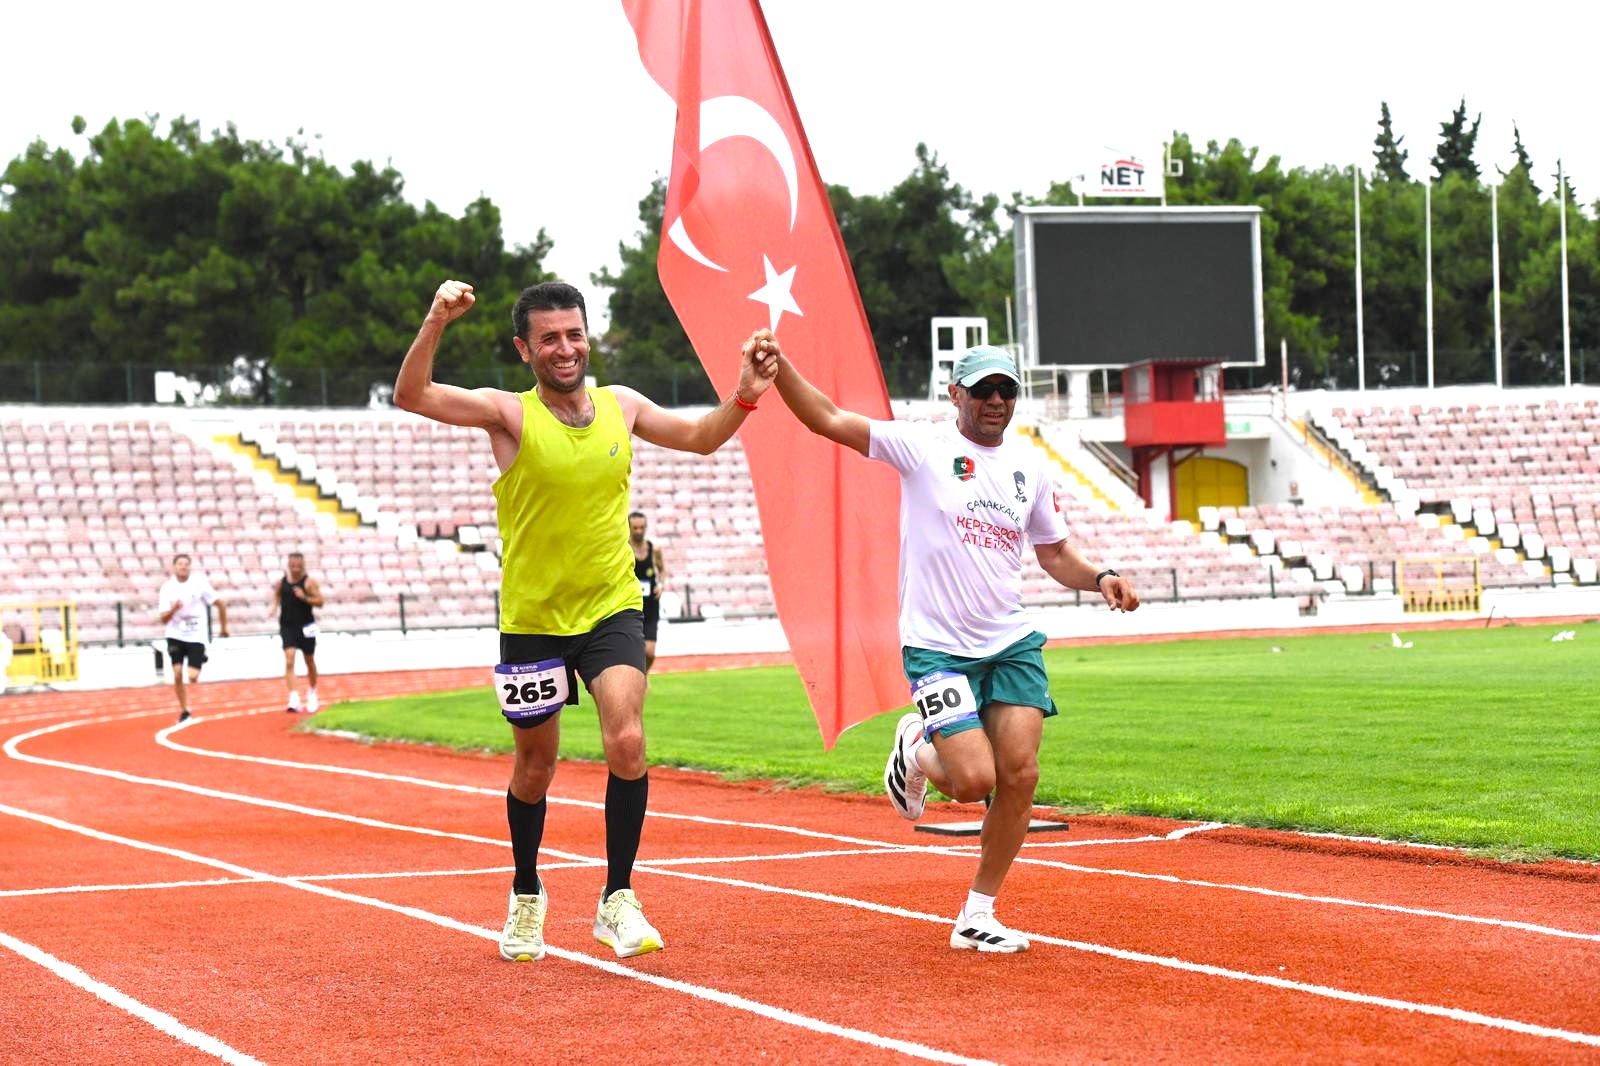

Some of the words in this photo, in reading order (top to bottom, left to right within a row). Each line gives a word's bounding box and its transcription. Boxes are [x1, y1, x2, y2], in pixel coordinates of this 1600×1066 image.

[1101, 167, 1145, 185] NET
[966, 500, 1021, 525] ÇANAKKALE
[503, 678, 557, 704] 265
[916, 687, 962, 720] 150
